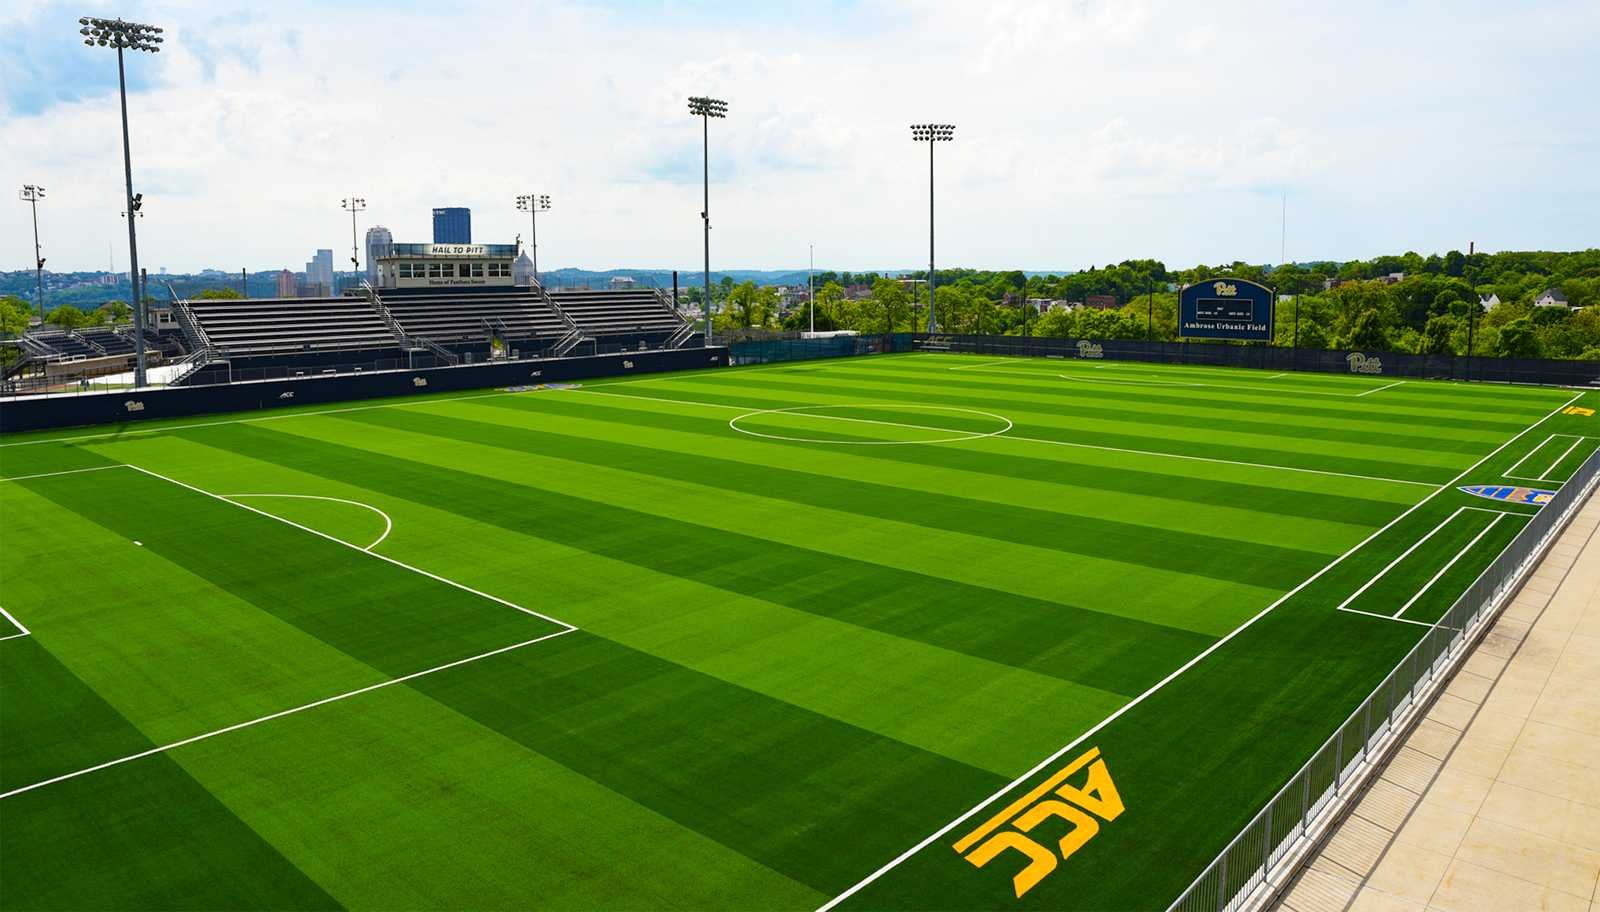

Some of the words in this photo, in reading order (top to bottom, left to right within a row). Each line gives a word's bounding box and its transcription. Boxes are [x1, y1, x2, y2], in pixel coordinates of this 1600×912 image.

[1345, 352, 1382, 373] Pitt
[279, 391, 295, 399] ACC
[963, 758, 1125, 898] ACC
